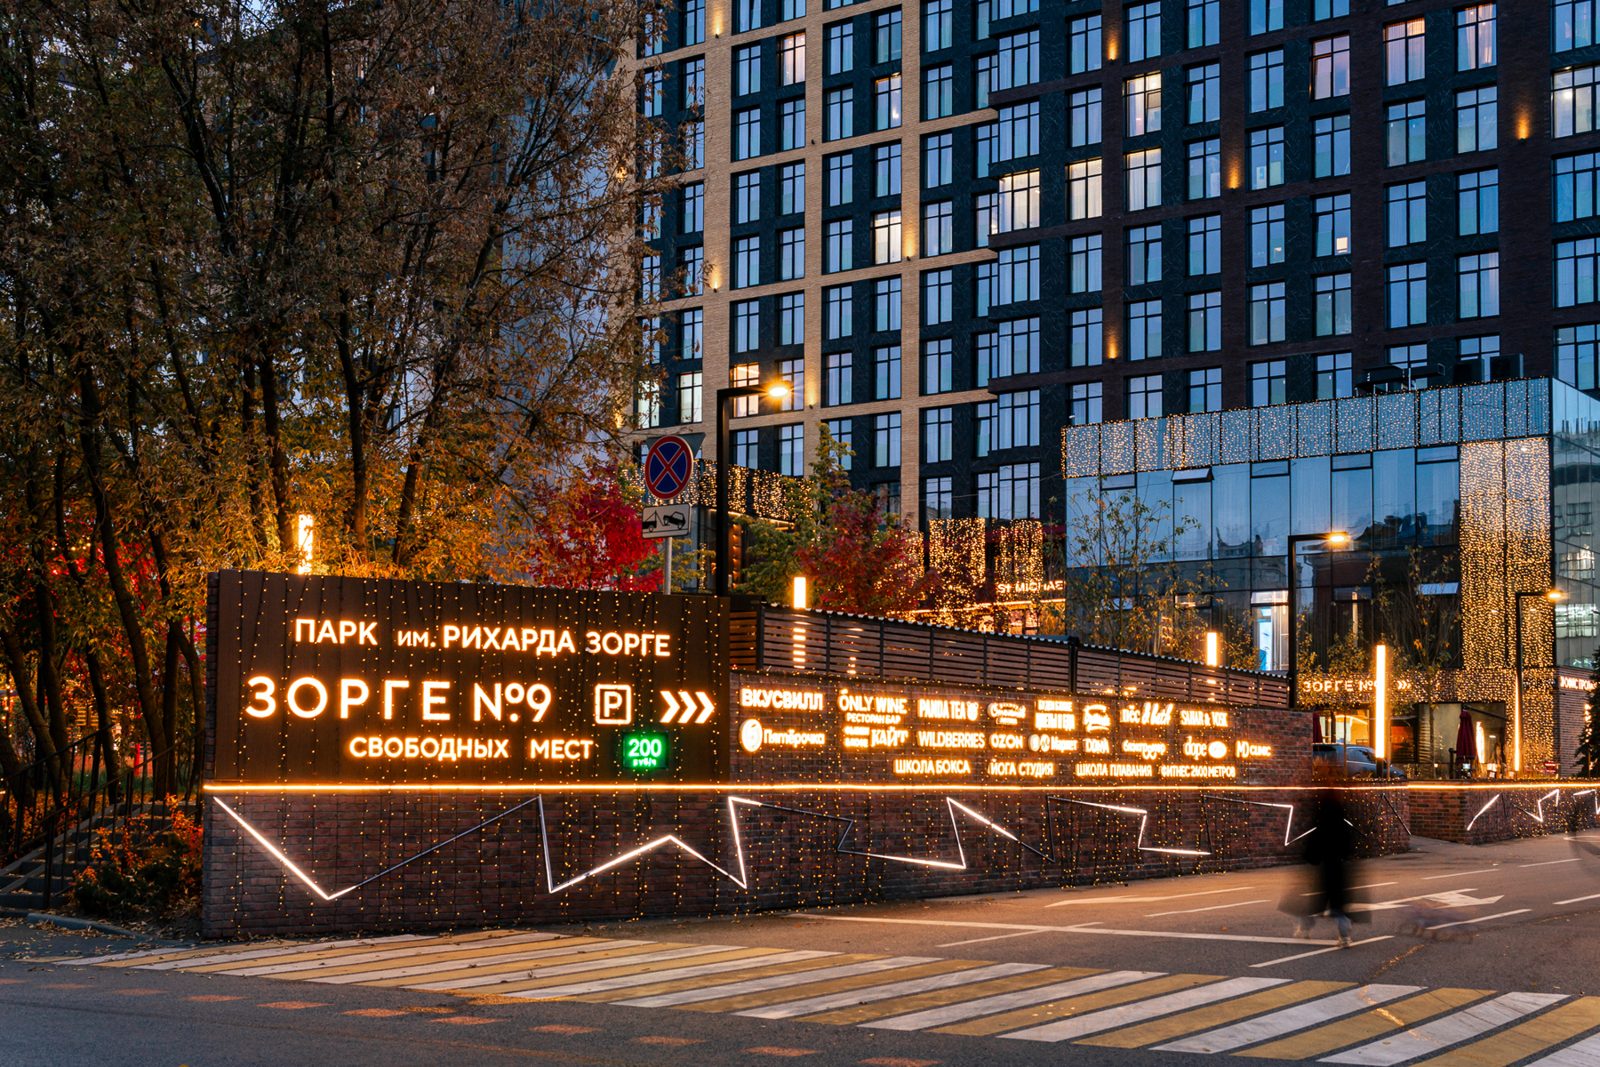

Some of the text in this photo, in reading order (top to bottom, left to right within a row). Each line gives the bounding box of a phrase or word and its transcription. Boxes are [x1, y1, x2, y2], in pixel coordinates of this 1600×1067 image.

[295, 618, 671, 657] ПАРК им. РИХАРДА ЗОРГЕ
[1303, 680, 1354, 693] ЗОРГЕ
[245, 676, 552, 723] ЗОРГЕ №9
[740, 688, 824, 711] ВКУСВИЛЛ
[875, 696, 908, 714] WINE
[918, 698, 949, 718] PANDA
[950, 700, 967, 719] TEA
[847, 712, 901, 725] РЕСТОРАН БАР
[349, 736, 594, 762] СВОБОДНЫХ МЕСТ
[628, 738, 662, 757] 200
[917, 730, 986, 749] WILDBERRIES
[990, 733, 1023, 749] OZON
[894, 759, 971, 775] ШКОЛА БОКСА
[988, 758, 1055, 778] ЙОГА СТУДИЯ
[1076, 763, 1153, 777] ШКОЛА ПЛАВАНИЯ
[1208, 765, 1236, 779] МЕТРОВ
